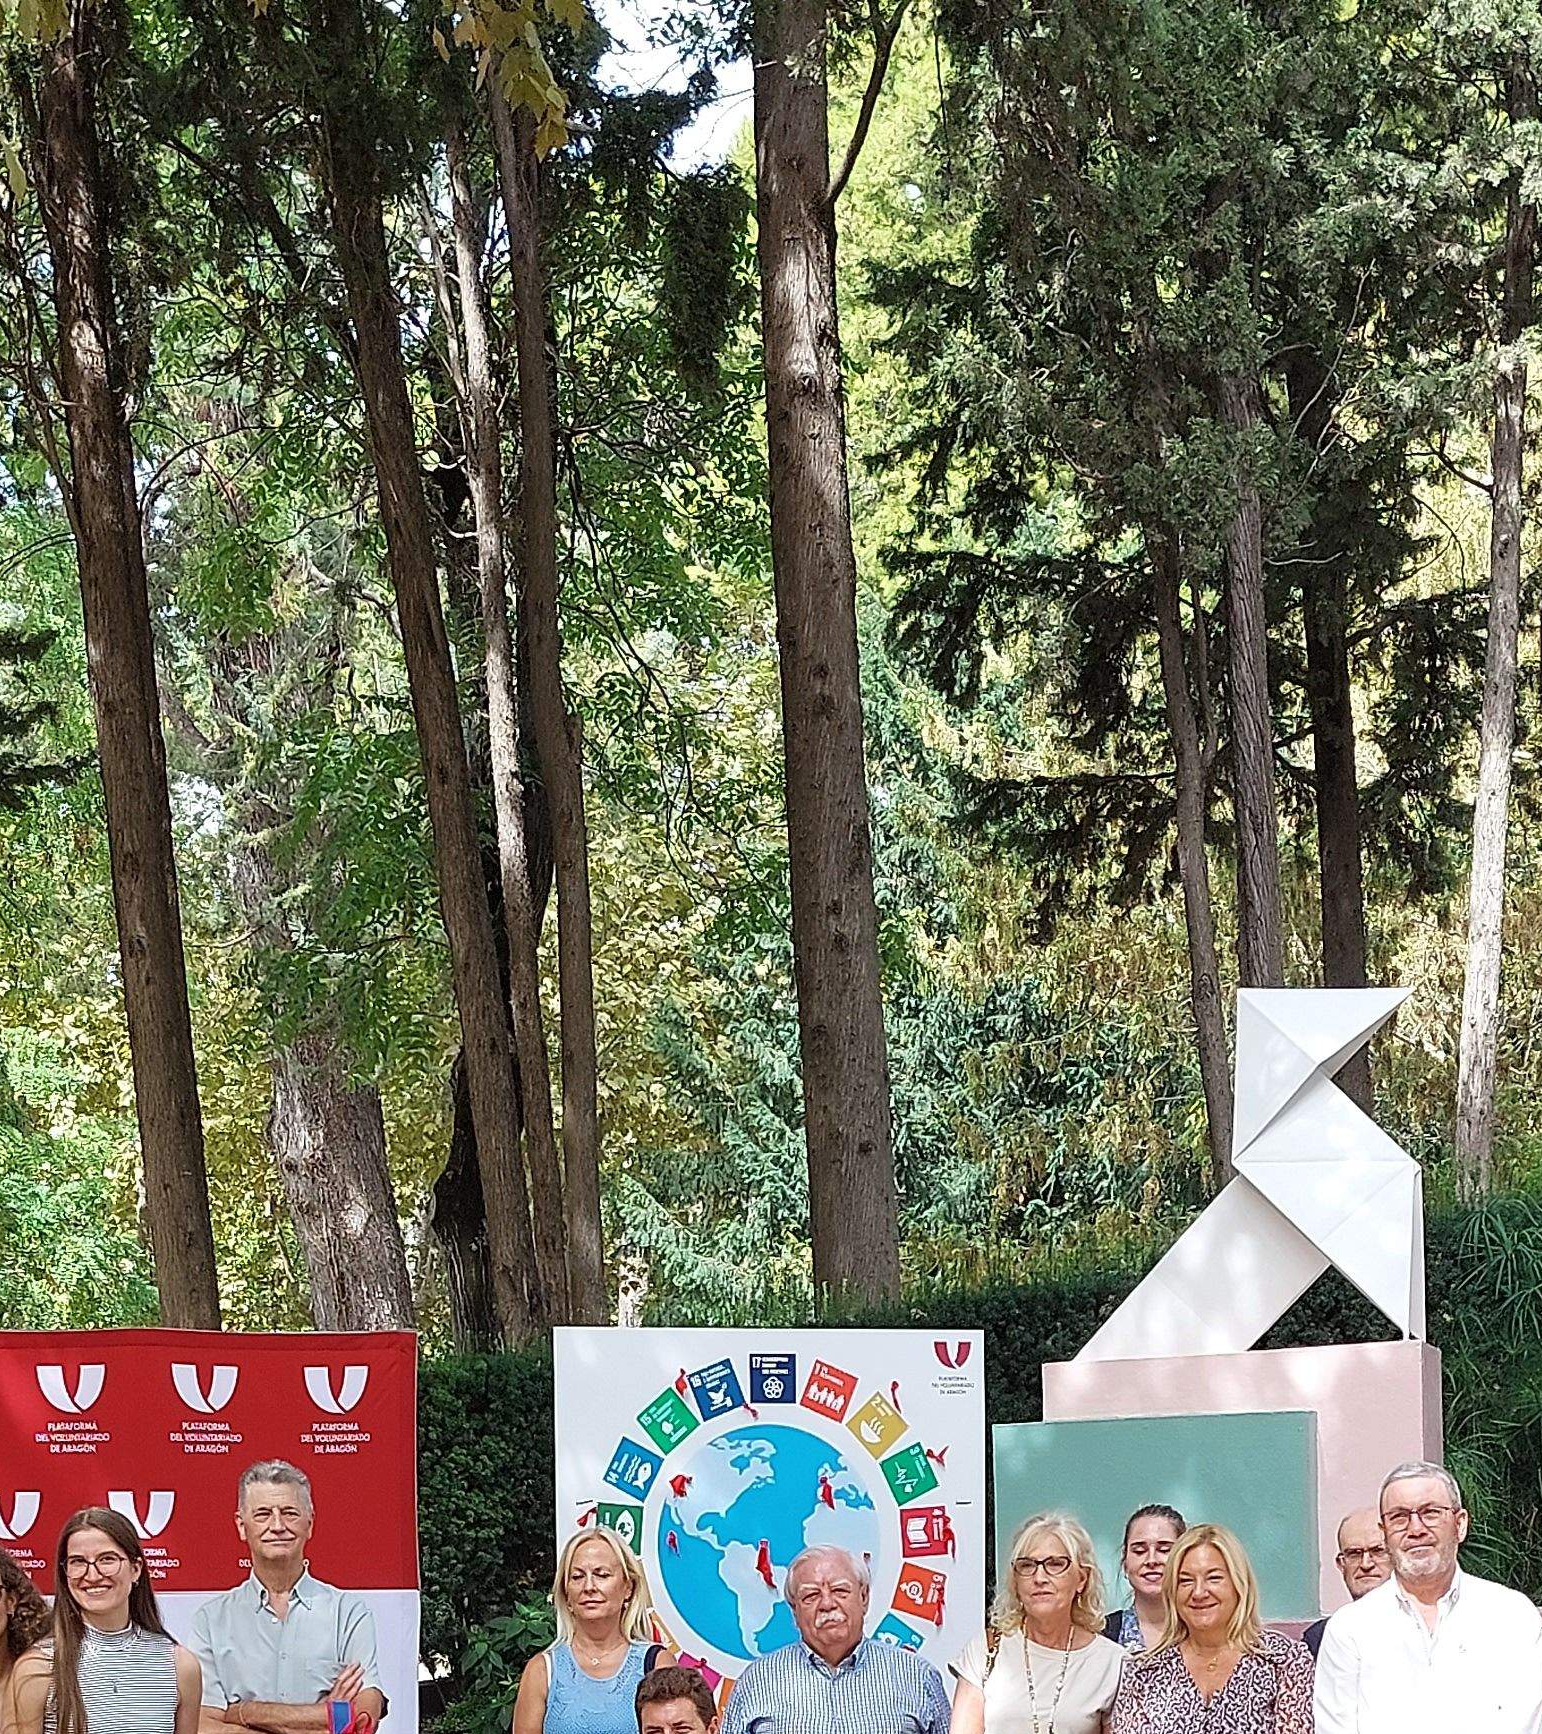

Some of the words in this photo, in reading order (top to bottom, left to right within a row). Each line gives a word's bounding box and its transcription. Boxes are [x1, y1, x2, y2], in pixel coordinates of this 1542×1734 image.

[48, 1422, 97, 1431] PLATAFORMA
[313, 1423, 358, 1431] PLATAFORMA
[170, 1433, 184, 1441] DEL
